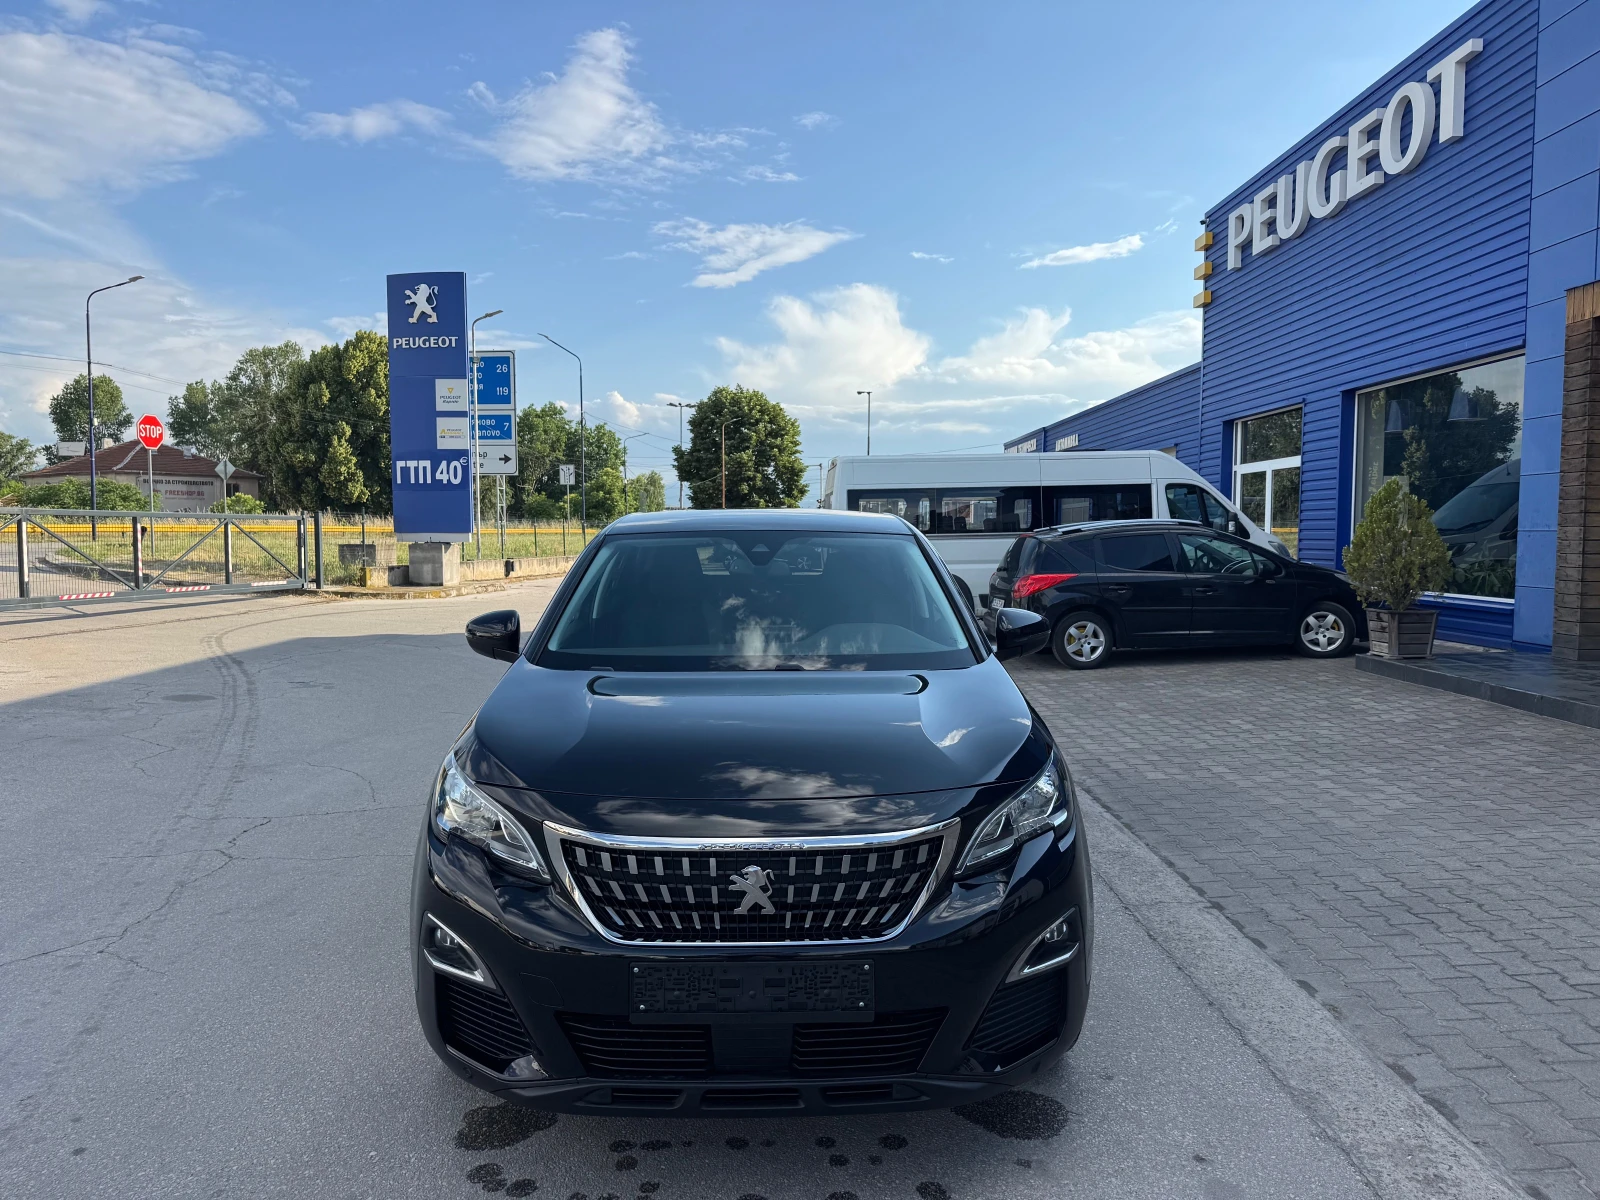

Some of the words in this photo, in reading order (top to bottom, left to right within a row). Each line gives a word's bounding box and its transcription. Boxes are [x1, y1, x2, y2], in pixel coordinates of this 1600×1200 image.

[1227, 38, 1484, 271] PEUGEOT
[393, 336, 458, 349] PEUGEOT
[496, 364, 508, 373] 26
[496, 386, 509, 396] 119
[140, 424, 162, 439] STOP
[503, 422, 510, 431] 7
[396, 460, 432, 484] ГТП
